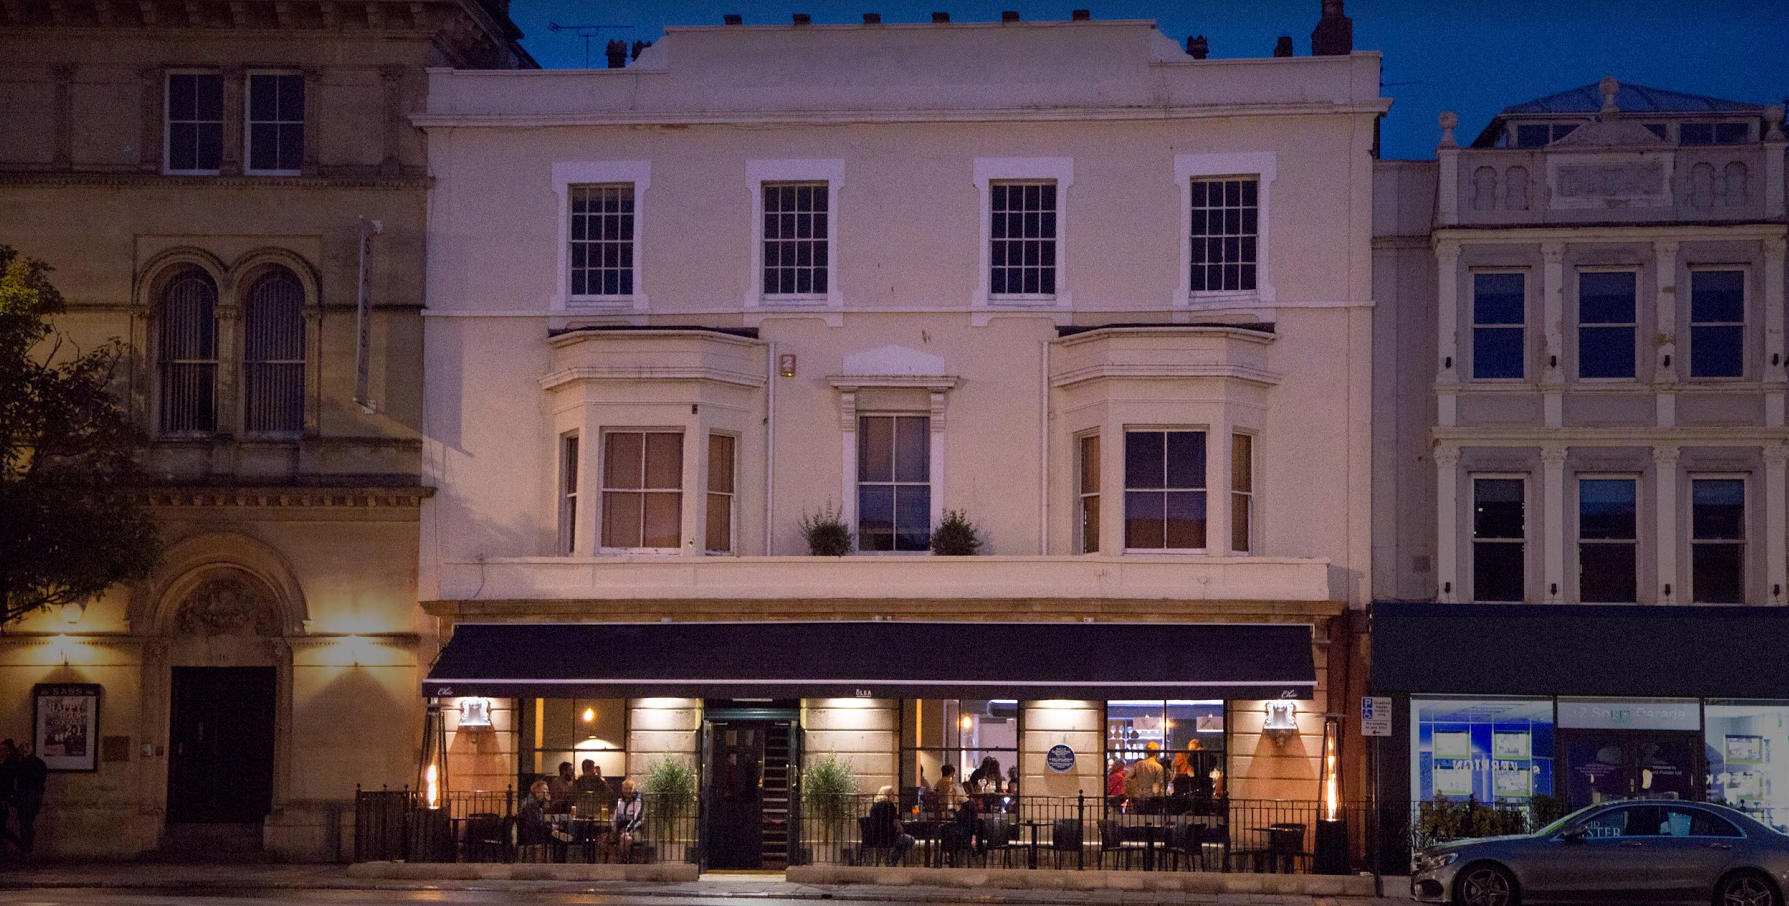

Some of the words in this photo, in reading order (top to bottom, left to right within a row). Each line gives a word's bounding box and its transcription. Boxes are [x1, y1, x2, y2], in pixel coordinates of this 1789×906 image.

[361, 236, 370, 348] SASS
[52, 687, 83, 695] SASS
[48, 703, 82, 712] HAPPY
